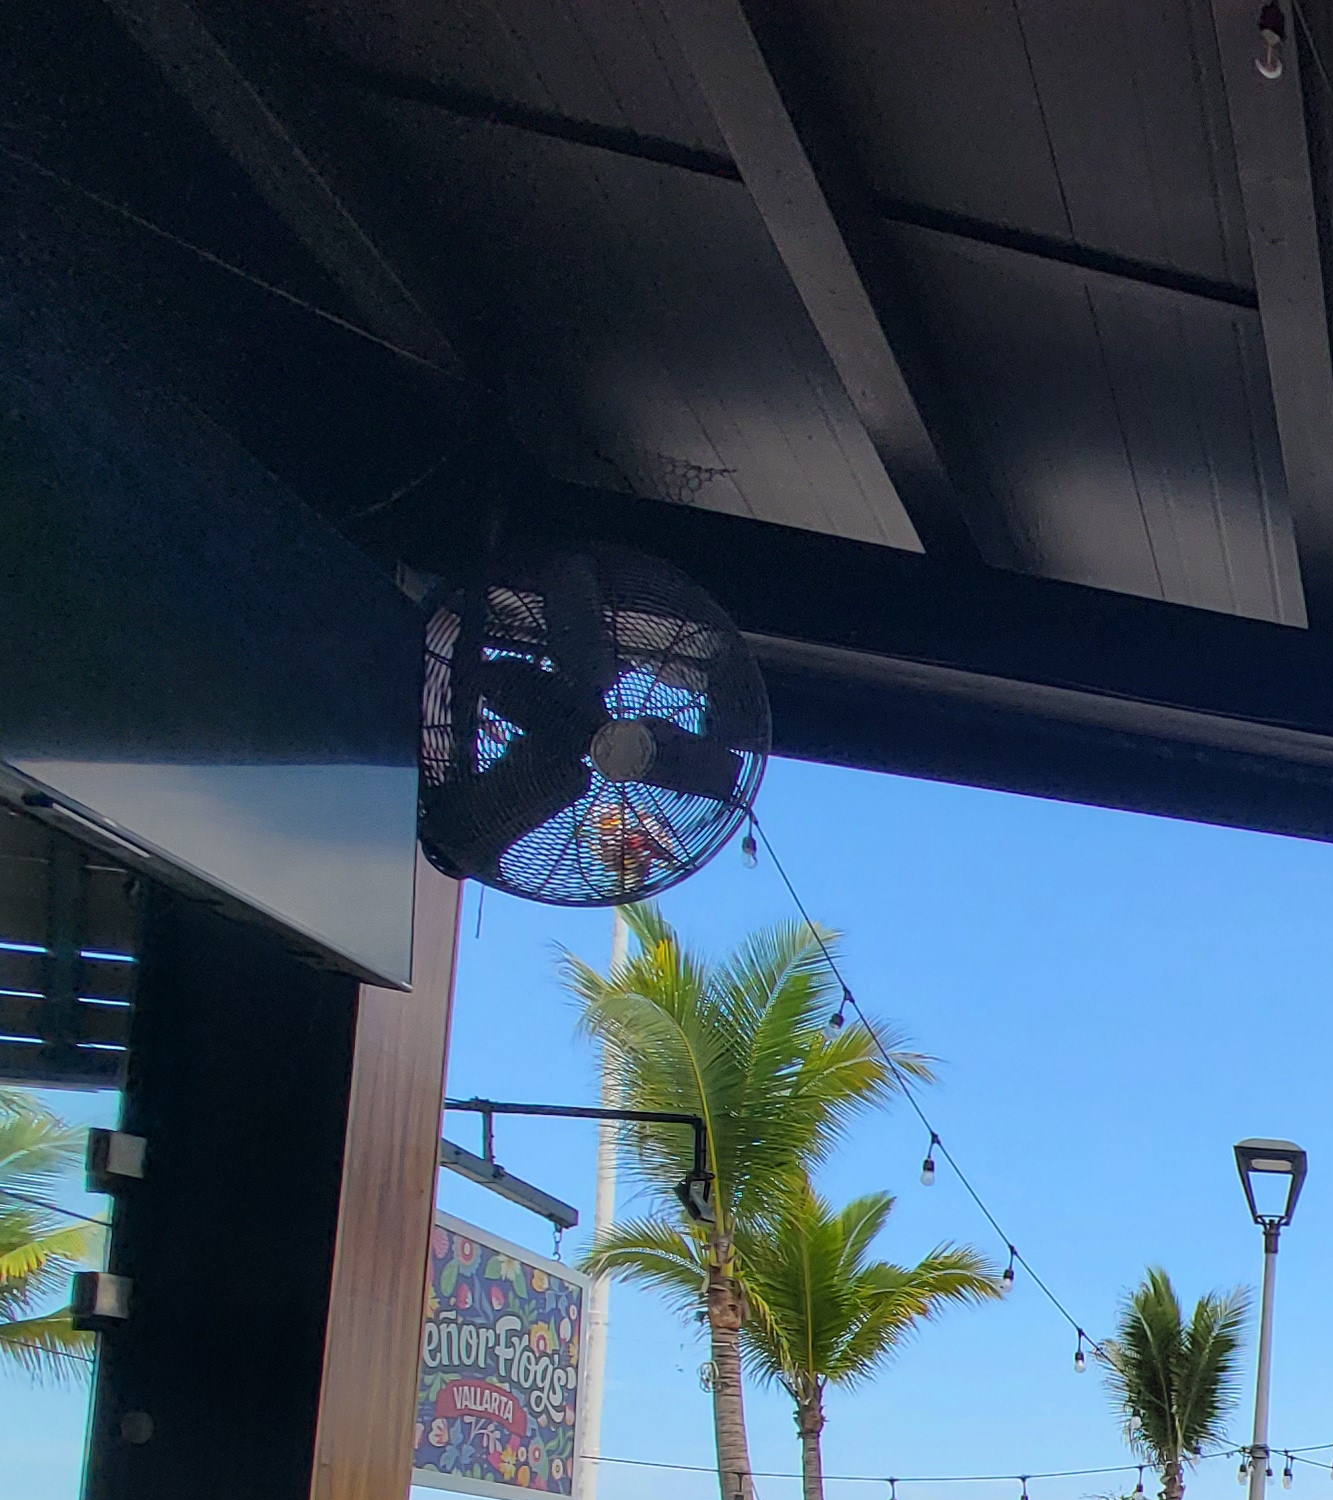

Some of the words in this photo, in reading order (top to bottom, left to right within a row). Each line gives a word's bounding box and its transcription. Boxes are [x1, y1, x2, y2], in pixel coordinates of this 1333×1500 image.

[422, 1310, 496, 1369] eñor
[494, 1314, 566, 1422] Frog's
[453, 1385, 514, 1424] VALLARTA
